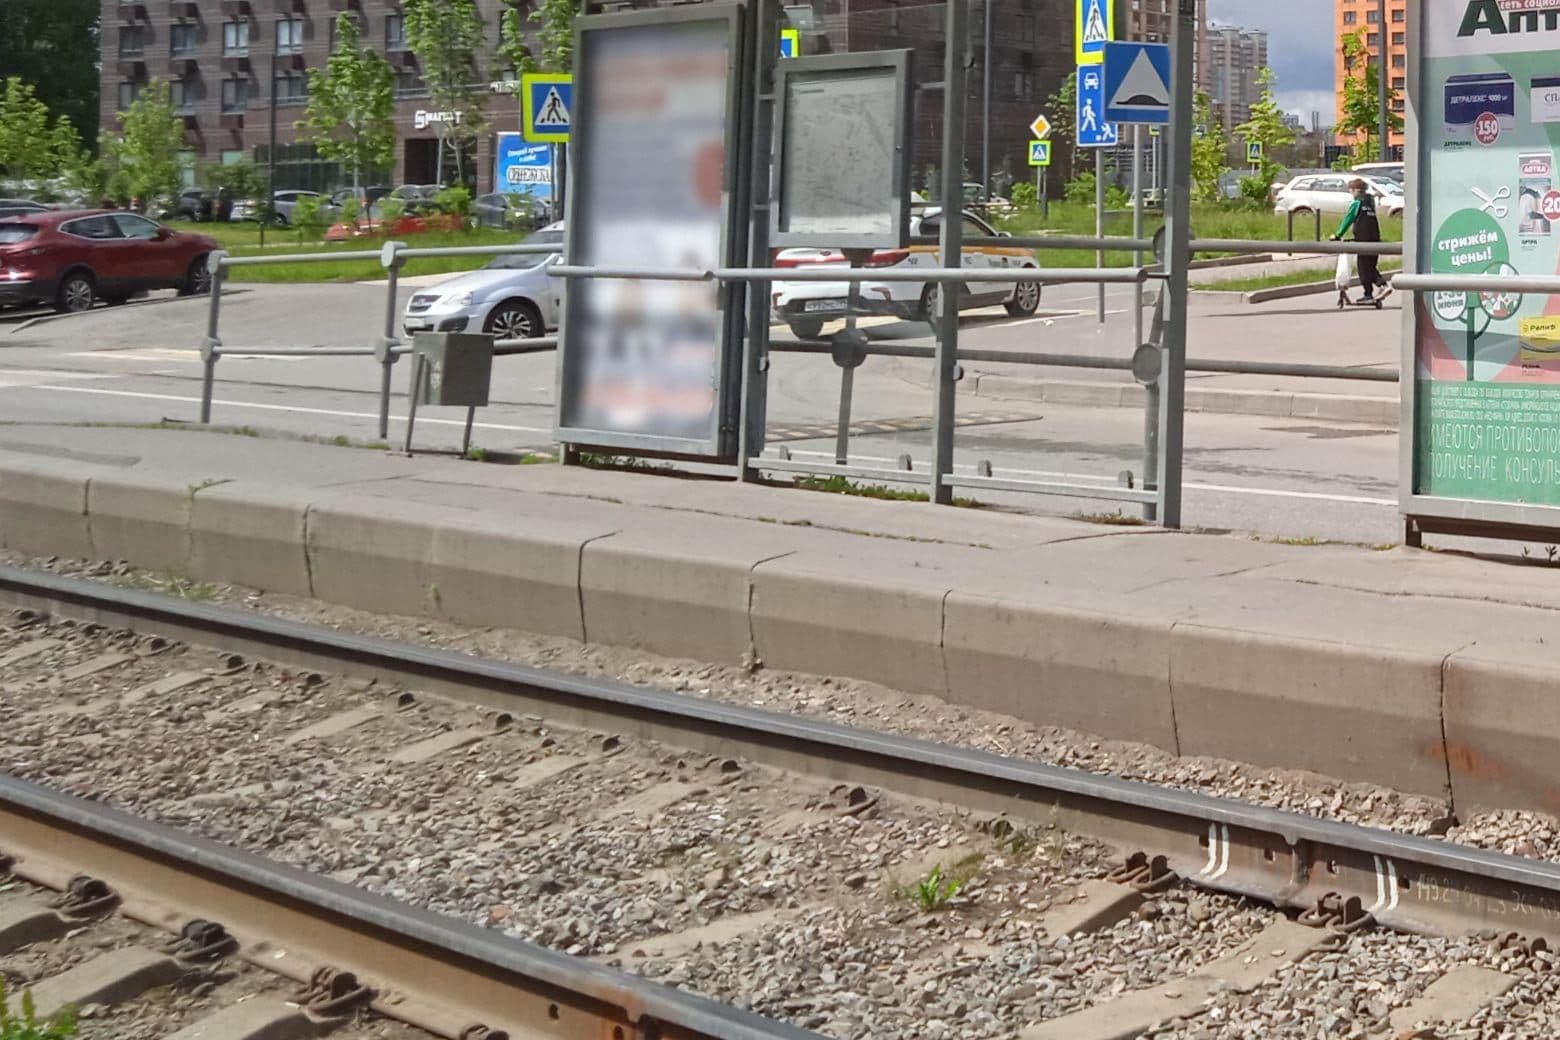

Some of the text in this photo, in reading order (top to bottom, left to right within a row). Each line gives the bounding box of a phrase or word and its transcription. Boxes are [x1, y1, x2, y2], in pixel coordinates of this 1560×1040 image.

[1500, 0, 1522, 10] сеть
[1438, 229, 1498, 252] стрижём
[1451, 246, 1492, 267] цены!
